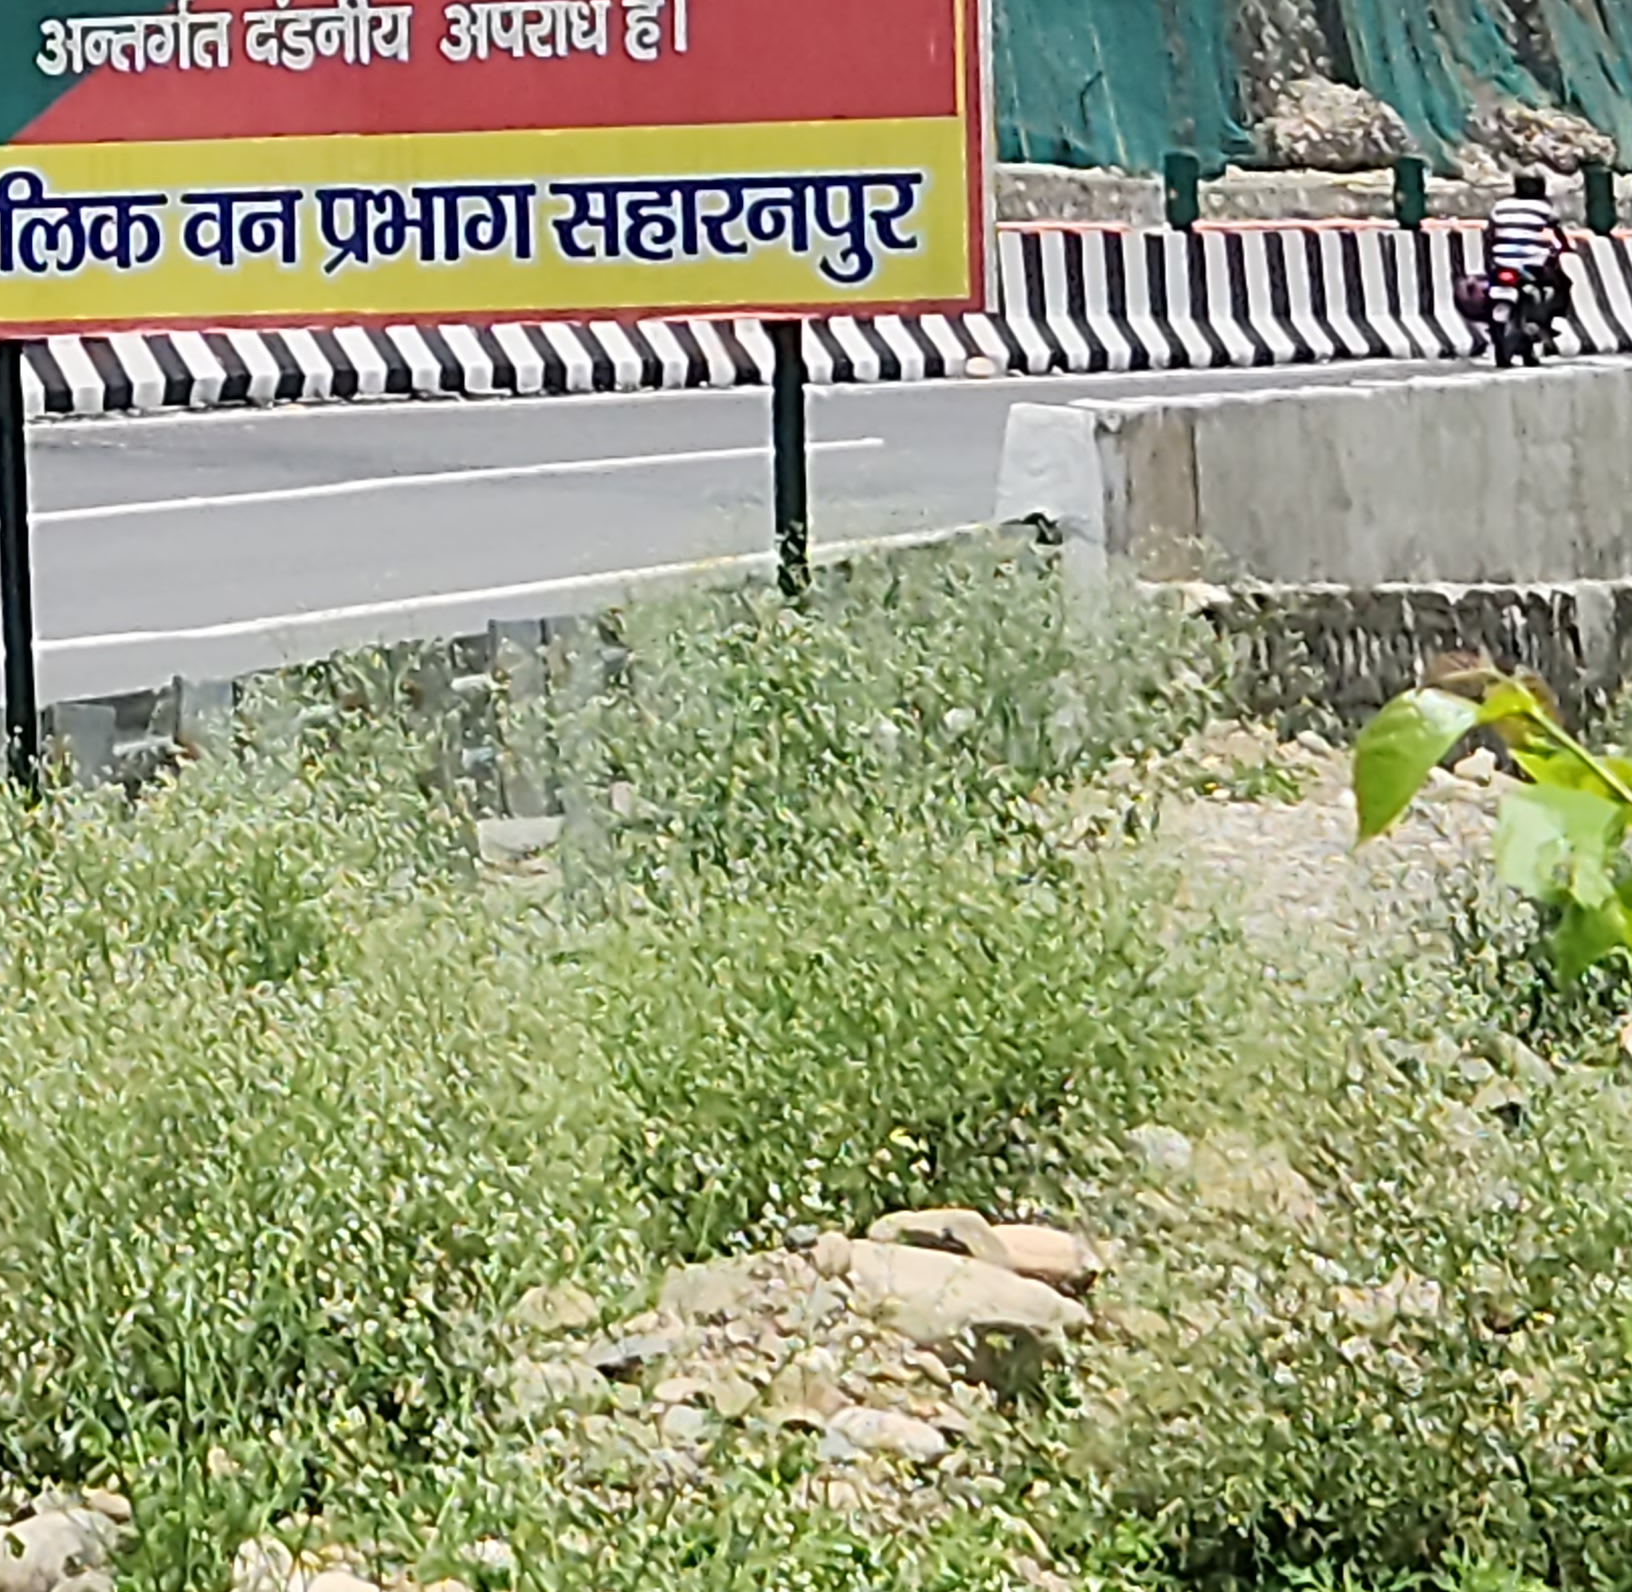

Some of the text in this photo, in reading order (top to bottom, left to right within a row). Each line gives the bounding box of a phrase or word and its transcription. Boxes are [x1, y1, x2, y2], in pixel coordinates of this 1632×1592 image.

[181, 189, 303, 265] वन
[315, 183, 536, 274] प्रभाग
[549, 172, 922, 283] सहारनपुर
